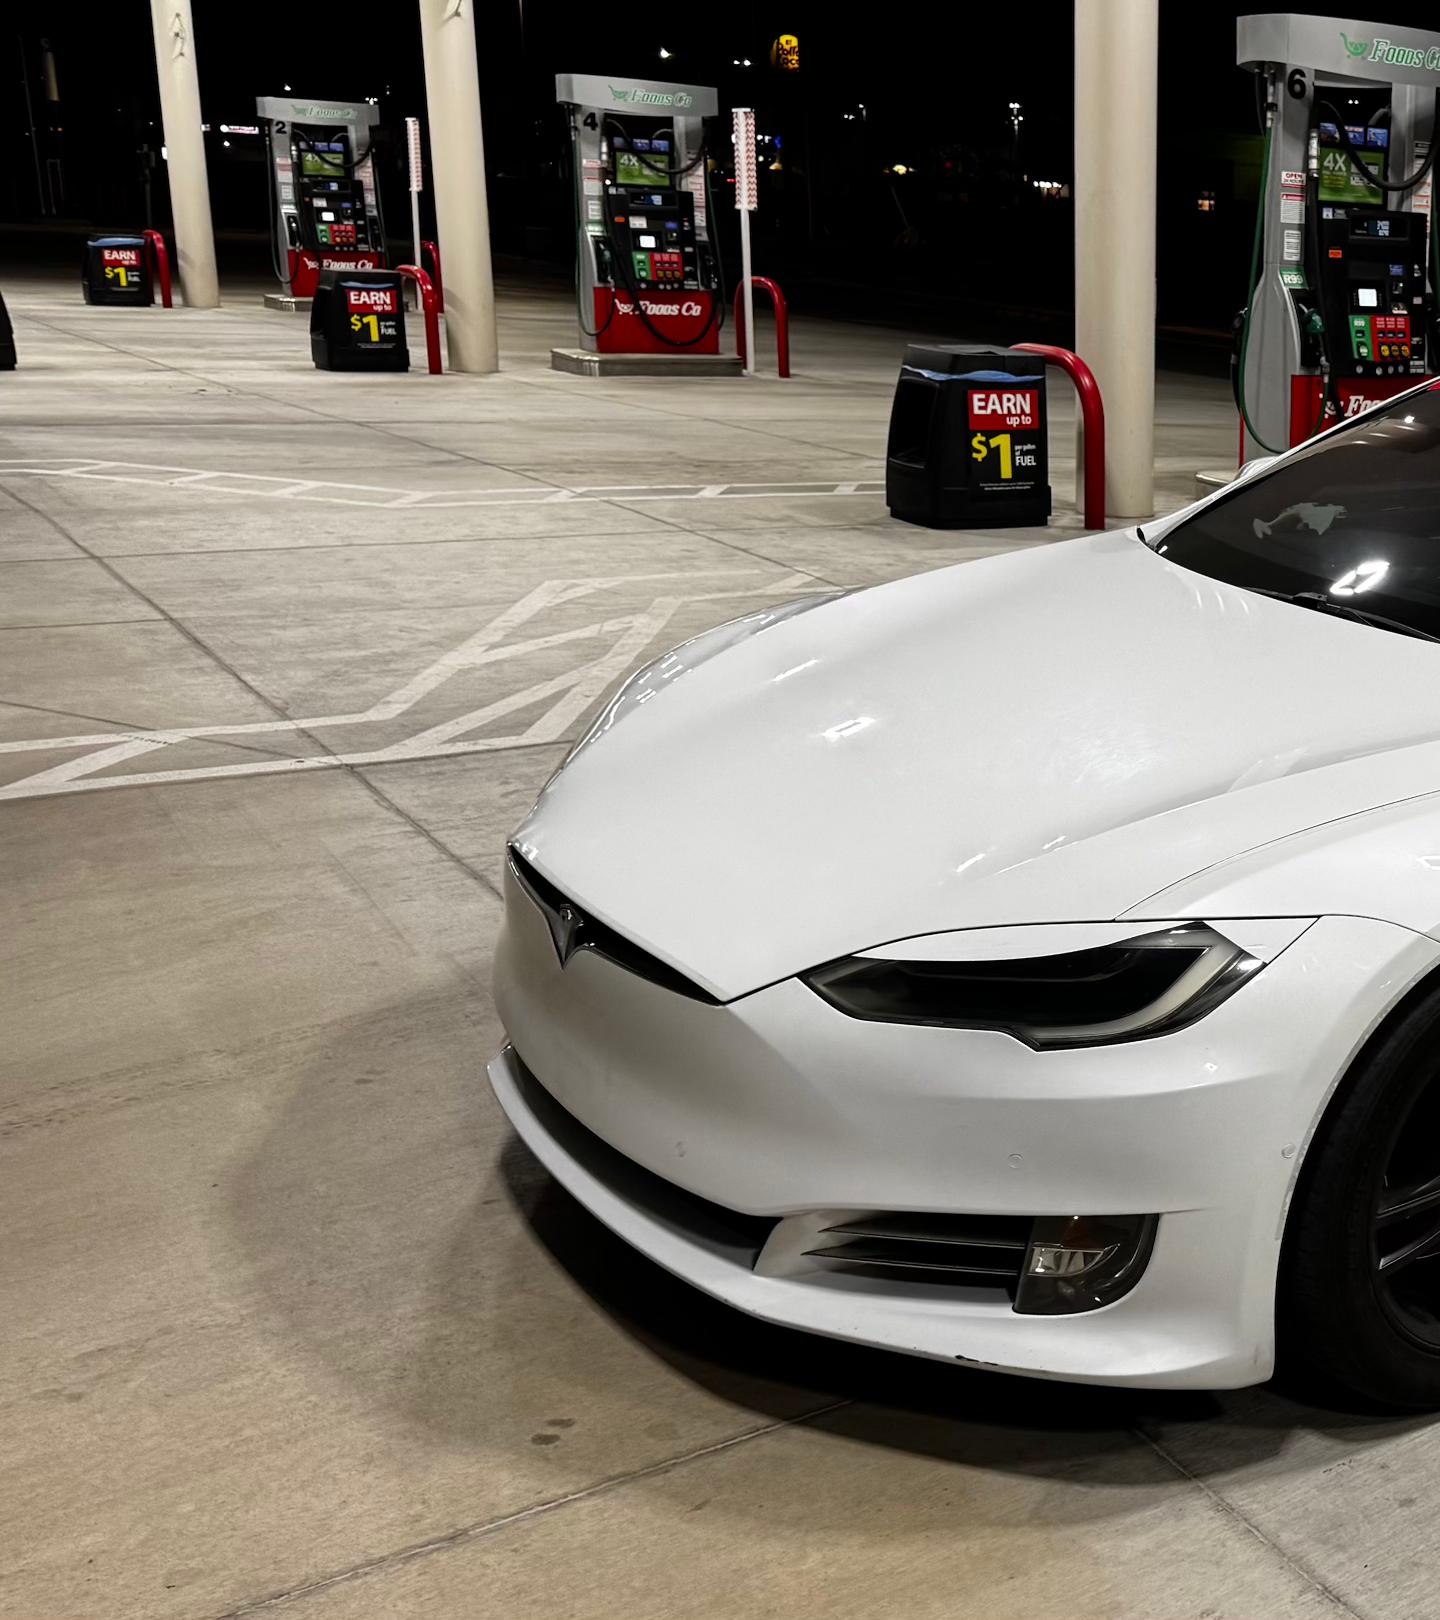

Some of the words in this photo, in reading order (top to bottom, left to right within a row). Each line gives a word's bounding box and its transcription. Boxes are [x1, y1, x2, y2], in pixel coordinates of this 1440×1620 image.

[1287, 68, 1307, 100] 6
[275, 121, 287, 135] 2
[583, 112, 598, 131] 4
[1323, 153, 1347, 171] 4X
[104, 249, 137, 260] EARN
[104, 266, 128, 287] $1
[350, 291, 391, 305] EARN
[350, 314, 380, 342] $1
[972, 393, 1031, 415] EARN
[1006, 417, 1020, 427] up
[1021, 415, 1032, 425] to
[971, 433, 1013, 479] $1
[1015, 456, 1037, 466] FUEL
